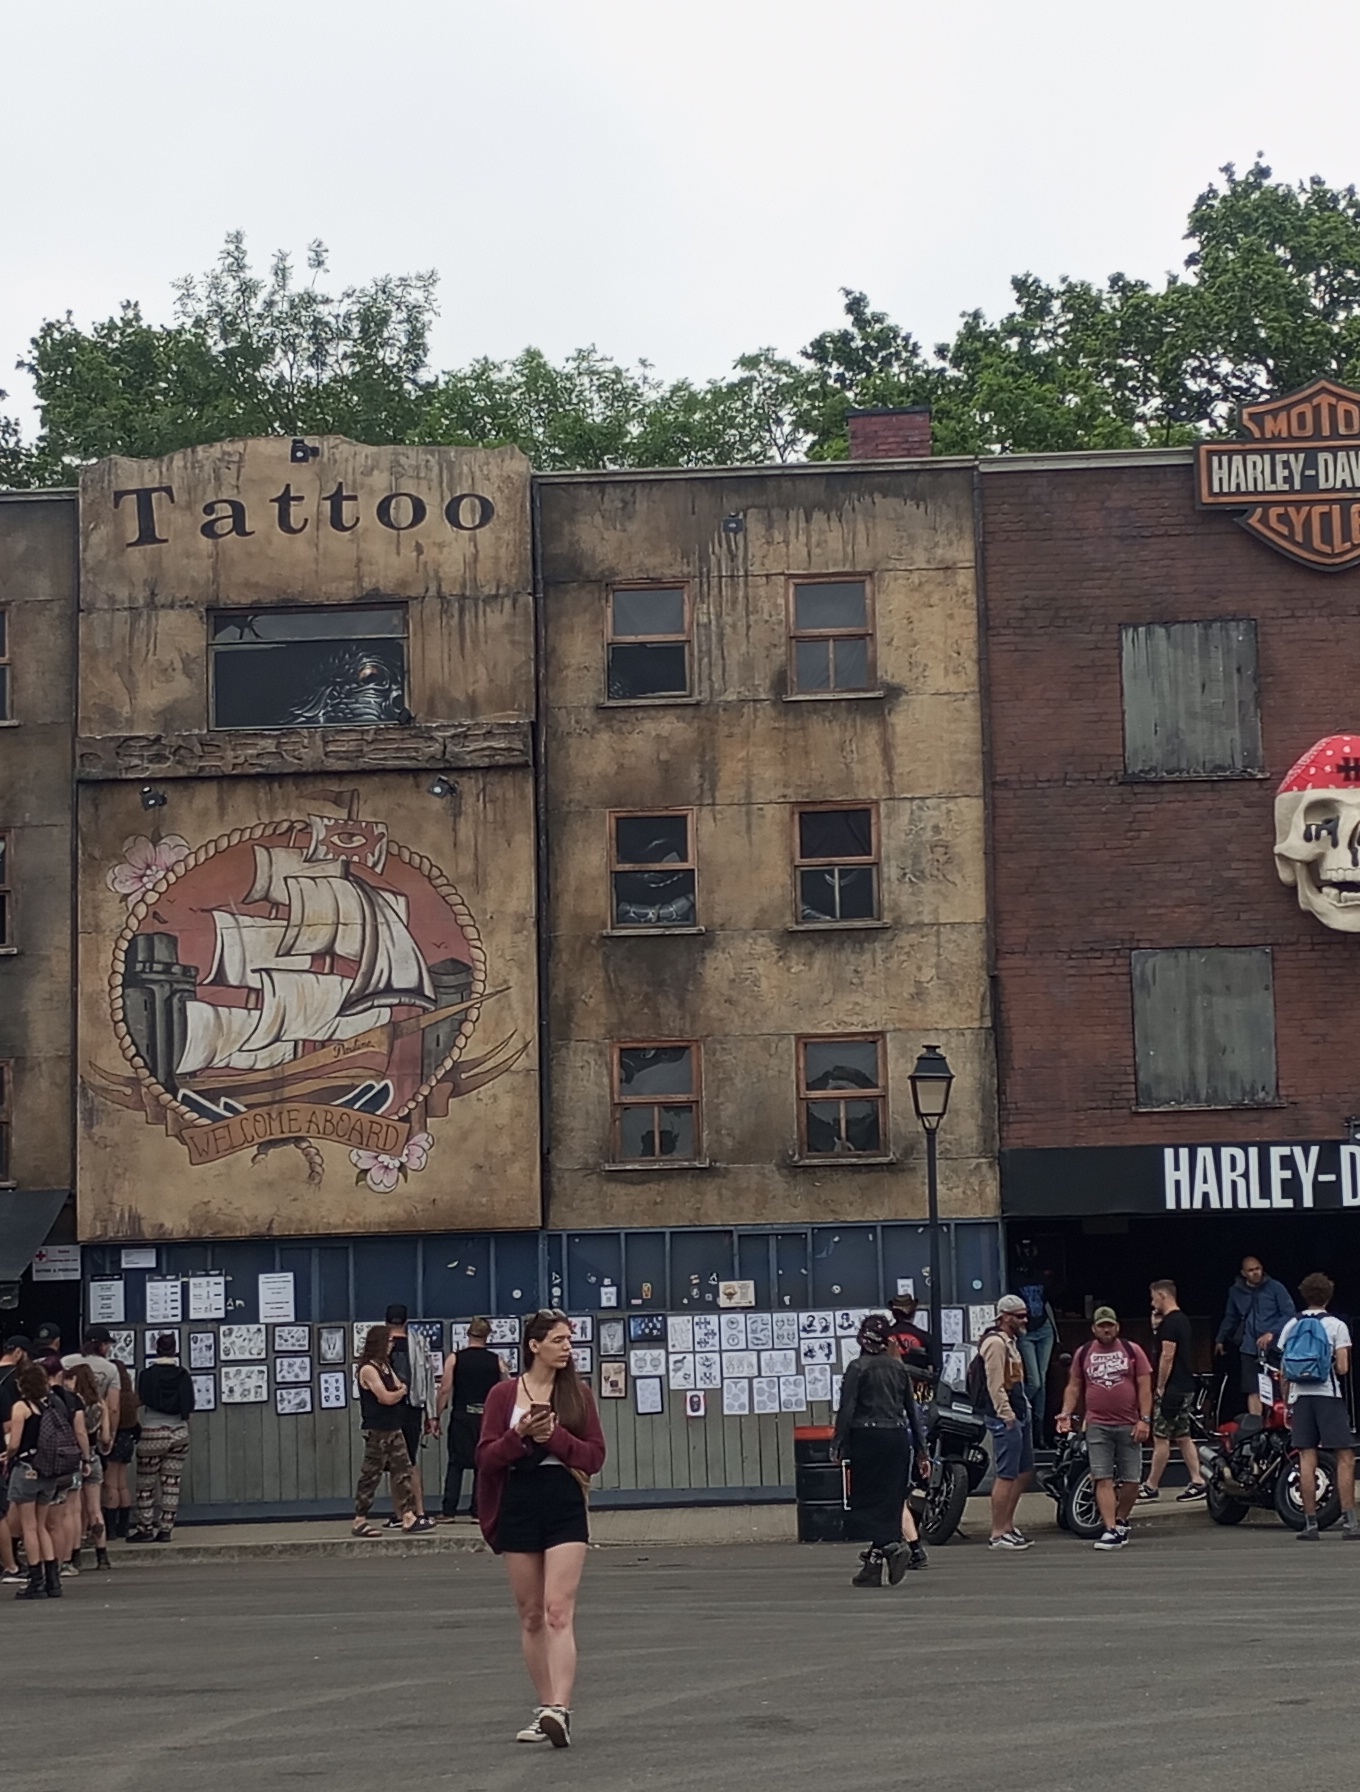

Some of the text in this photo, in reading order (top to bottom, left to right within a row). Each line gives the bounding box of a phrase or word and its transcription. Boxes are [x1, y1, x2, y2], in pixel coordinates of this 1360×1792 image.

[113, 481, 496, 549] Tattoo
[190, 1109, 399, 1157] WELCOME ABOARD
